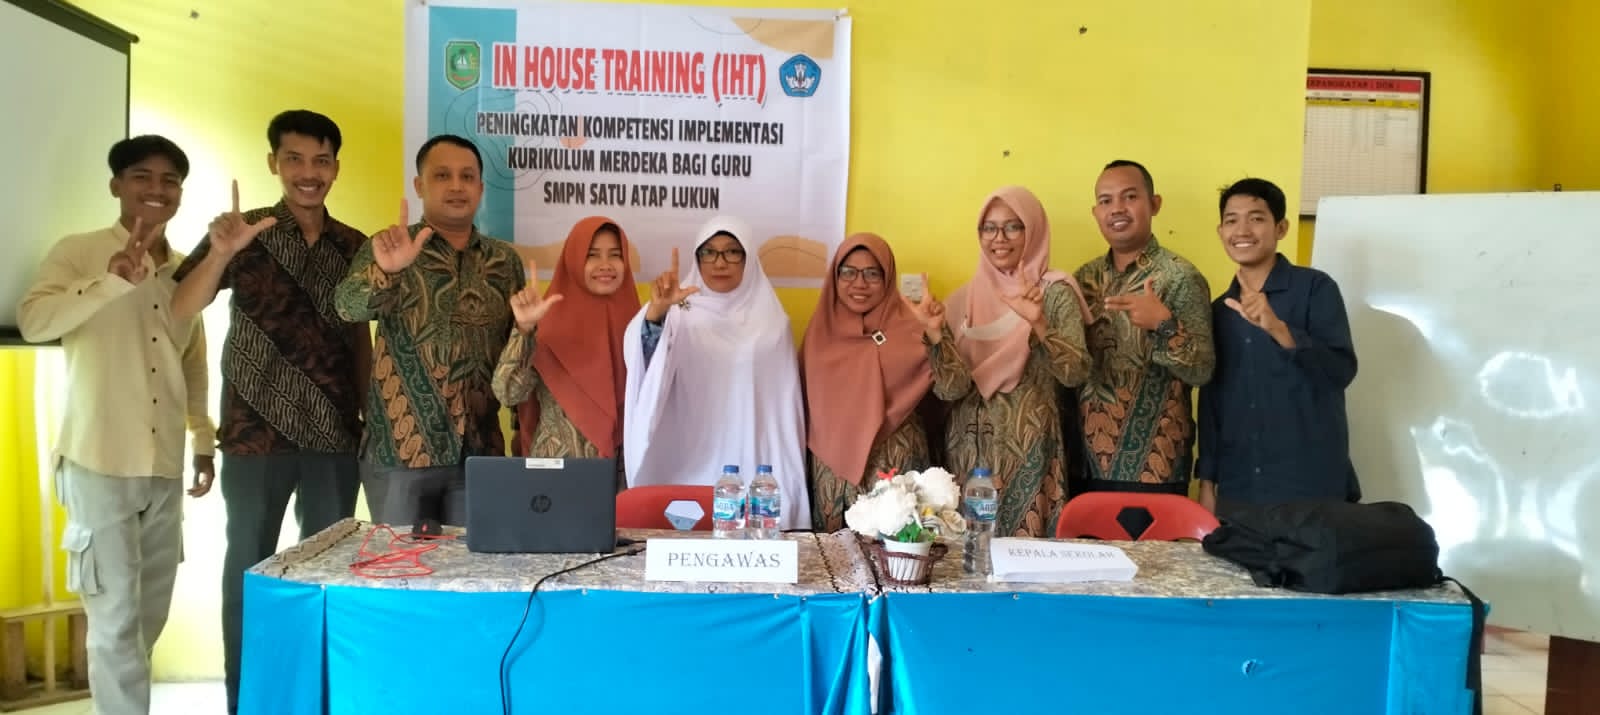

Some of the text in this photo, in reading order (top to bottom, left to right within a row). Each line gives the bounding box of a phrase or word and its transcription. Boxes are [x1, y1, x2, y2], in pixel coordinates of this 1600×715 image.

[494, 44, 766, 104] IN HOUSE TRAINING (IHT)
[477, 112, 783, 144] PENINGKATAN KOMPETENSI IMPLEMENTASI
[508, 147, 751, 177] KURIKULUM MERDEKA BAGI GURU
[543, 181, 720, 209] SMPN SATU ATAP LUKUN
[668, 552, 781, 568] PENGAWAS
[1008, 547, 1057, 558] KEPALA
